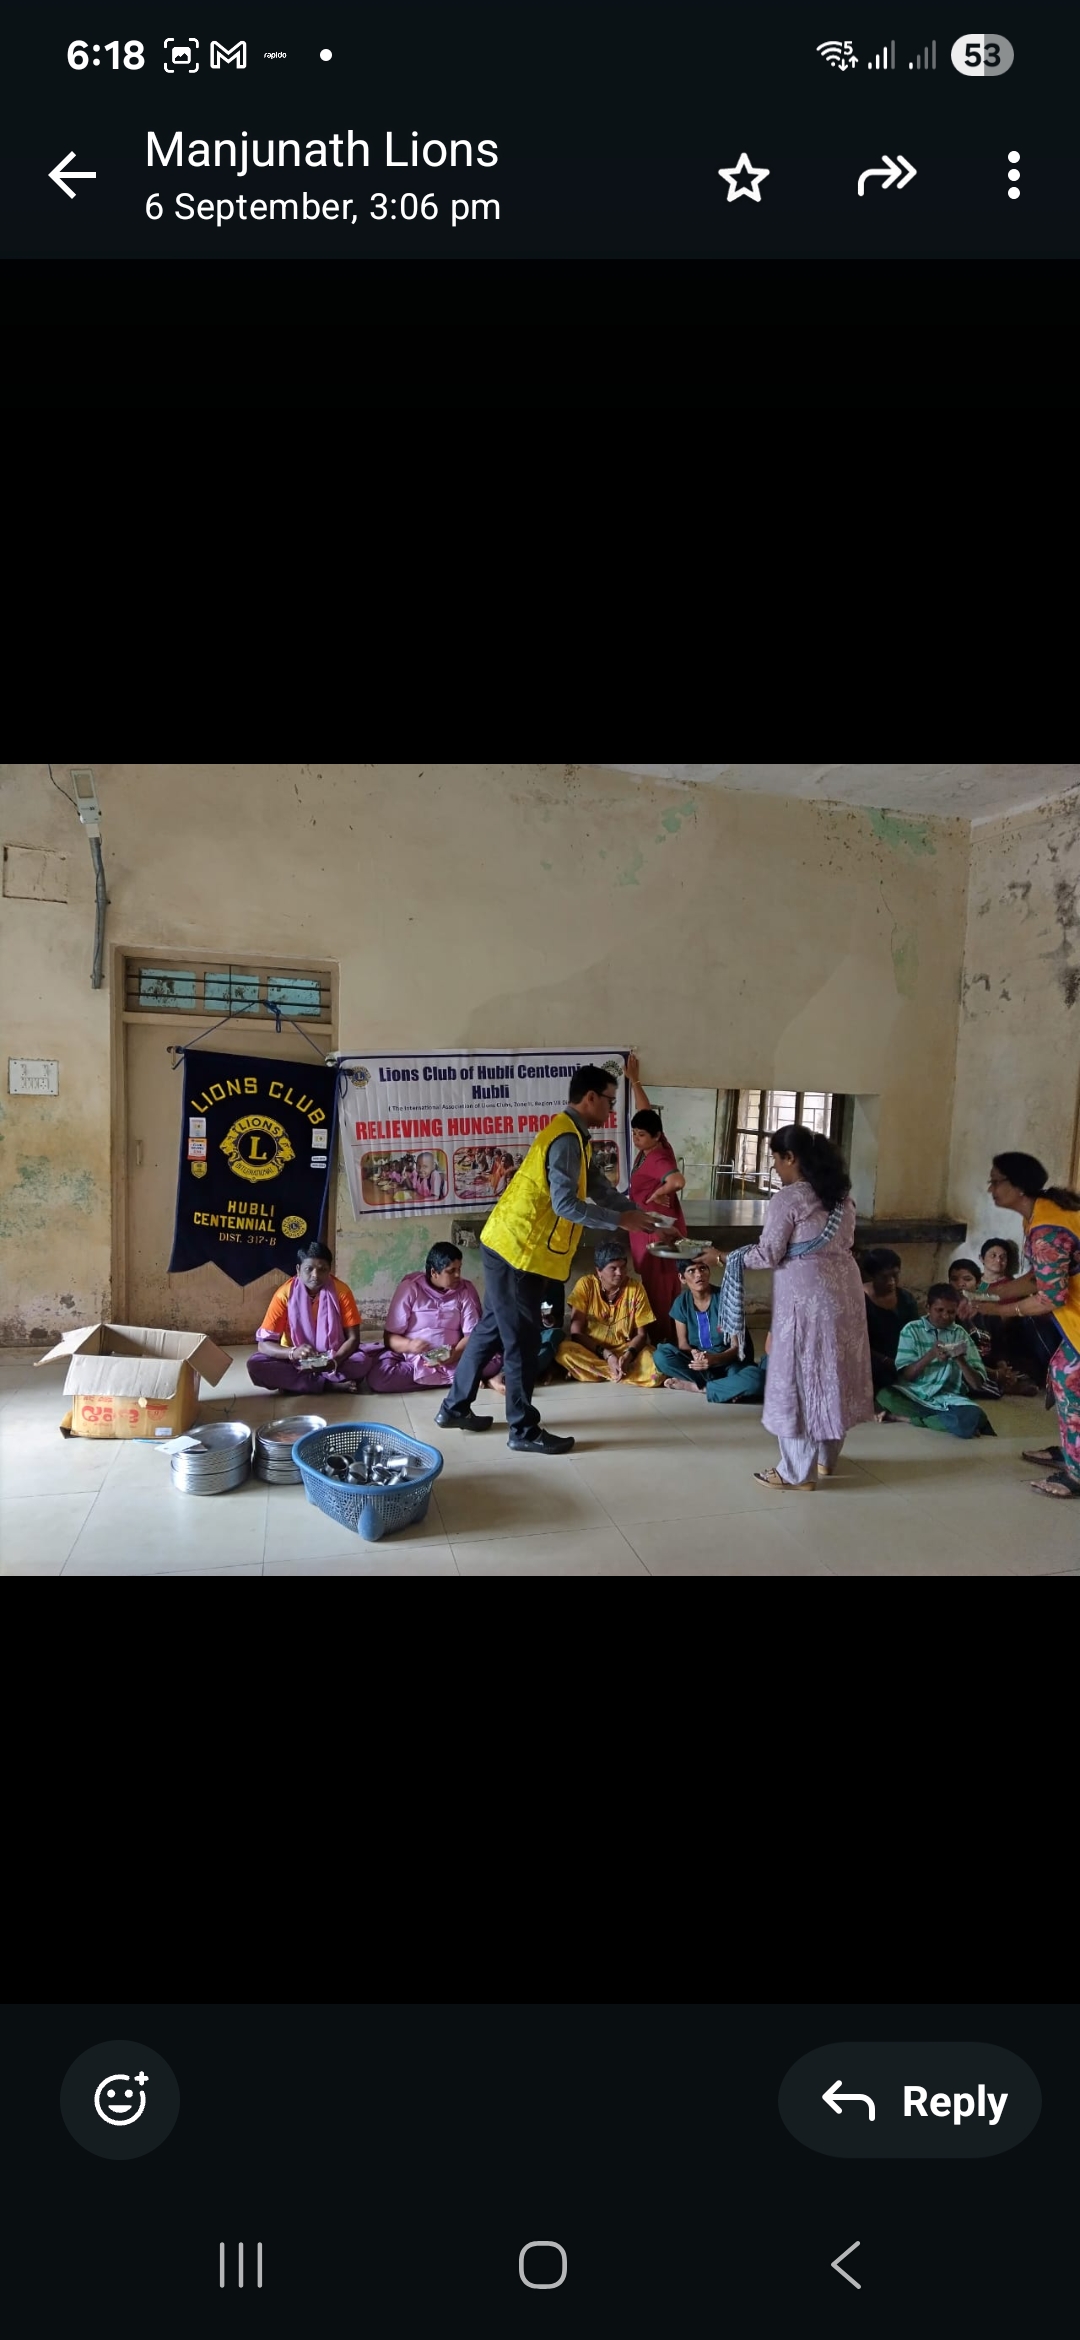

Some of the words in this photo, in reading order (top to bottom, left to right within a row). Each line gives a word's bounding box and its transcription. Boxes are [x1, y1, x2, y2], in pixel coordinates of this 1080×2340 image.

[379, 1067, 419, 1082] Lions
[423, 1066, 457, 1081] Club
[460, 1066, 474, 1080] of
[478, 1065, 514, 1080] Hubli
[191, 1077, 258, 1113] LIONS
[268, 1081, 326, 1125] CLUB
[472, 1085, 510, 1100] Hubli
[238, 1117, 281, 1135] LIONS
[356, 1119, 443, 1140] RELIEVING
[447, 1115, 513, 1136] HUNGER
[248, 1136, 268, 1160] L
[227, 1200, 275, 1217] HUBLI
[193, 1211, 276, 1233] CENTENNIAL
[219, 1232, 242, 1243] DIST.
